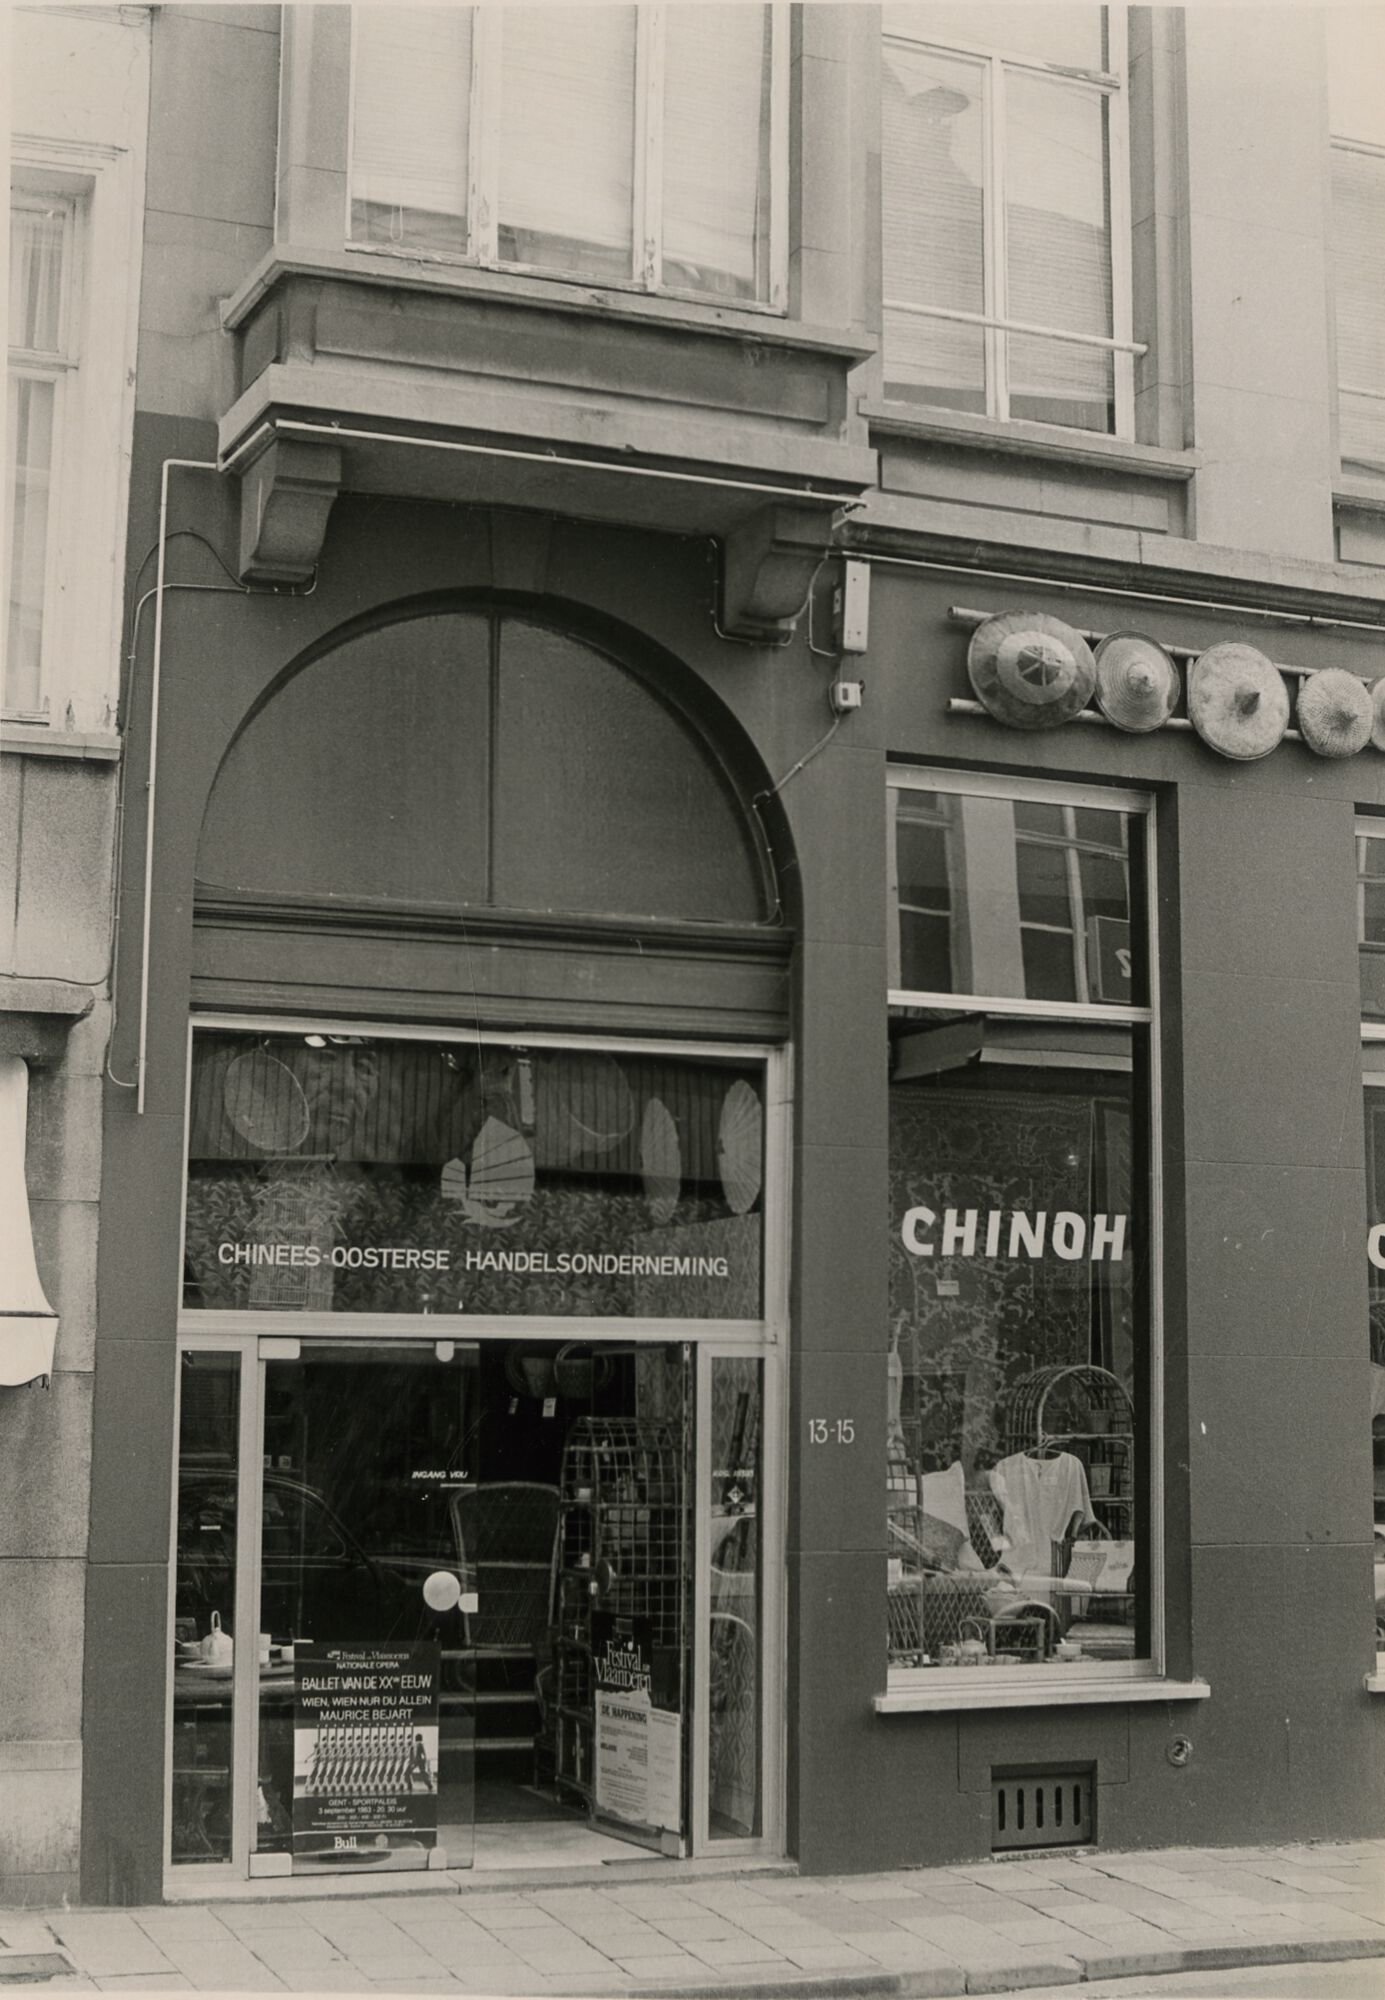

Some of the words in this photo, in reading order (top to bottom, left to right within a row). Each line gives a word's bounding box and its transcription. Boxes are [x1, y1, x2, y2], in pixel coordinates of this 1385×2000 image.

[901, 1205, 1127, 1261] CHINOH
[217, 1242, 450, 1270] CHINEES-OOSTERSE
[465, 1250, 729, 1277] HANDELSONDERNEMING
[808, 1418, 855, 1444] 13-15
[411, 1470, 447, 1479] INGANG
[606, 1639, 641, 1672] Festival
[336, 1661, 375, 1670] NATIONALE
[375, 1661, 400, 1669] OPERA
[301, 1676, 340, 1690] BALLET
[341, 1676, 362, 1690] VAN
[363, 1676, 378, 1689] DE
[400, 1674, 433, 1689] EEUW
[301, 1696, 330, 1707] WIEN,
[331, 1696, 358, 1706] WIEN
[359, 1696, 381, 1706] NUR
[382, 1696, 397, 1706] DU
[398, 1695, 432, 1705] ALLEIN
[319, 1709, 370, 1721] MAURICE
[371, 1708, 413, 1720] BEJART
[328, 1799, 348, 1807] GENT
[352, 1797, 398, 1806] SPORTPALEIS
[333, 1836, 358, 1849] Bull
